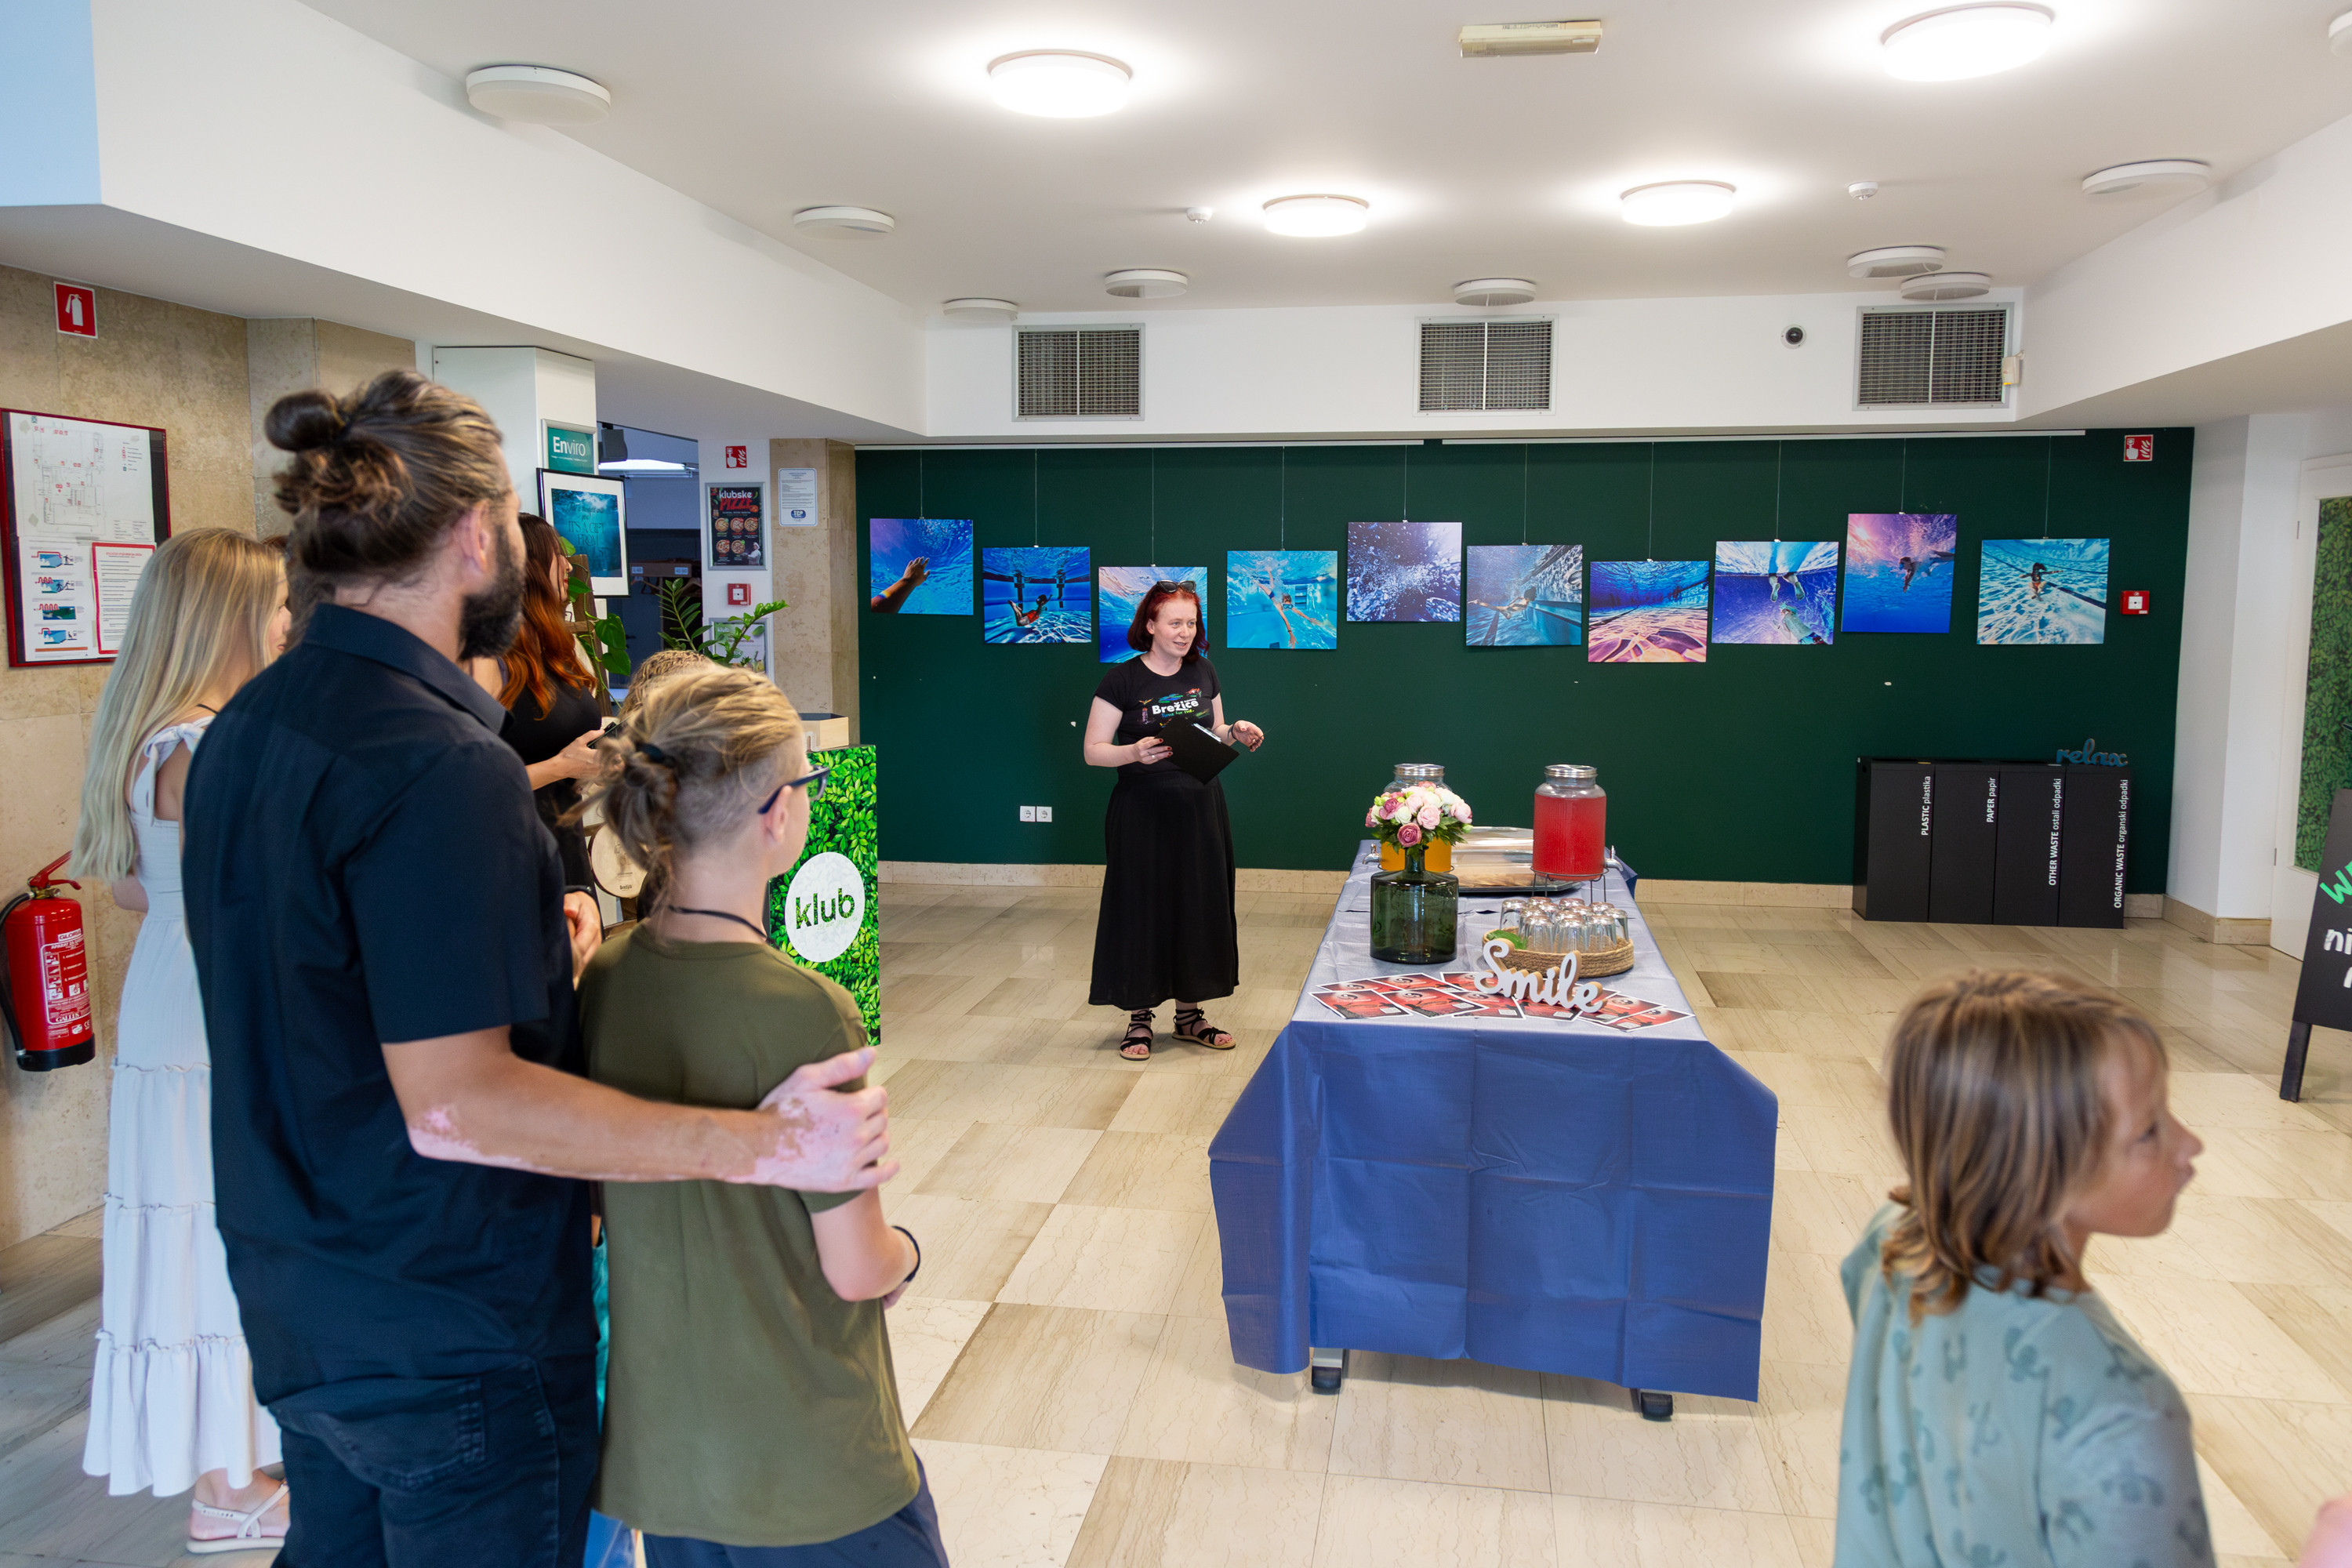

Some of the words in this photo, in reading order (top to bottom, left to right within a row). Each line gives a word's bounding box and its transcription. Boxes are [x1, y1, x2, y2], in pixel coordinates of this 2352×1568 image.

[553, 436, 586, 456] Enviro
[719, 490, 753, 499] klubske
[720, 498, 753, 511] PIZZE
[577, 534, 598, 546] FROM
[590, 522, 604, 534] GIFT
[1152, 699, 1199, 715] Brežice
[2056, 739, 2129, 768] relax
[1922, 776, 1932, 804] plastika
[1988, 777, 1998, 797] papir
[2053, 779, 2063, 809] odpadki
[2118, 779, 2129, 810] odpadki
[1921, 805, 1930, 836] PLASTIC
[1986, 798, 1995, 823] PAPER
[2051, 810, 2060, 830] ostali
[2118, 811, 2128, 843] organski
[2049, 831, 2059, 858] WASTE
[2115, 844, 2125, 871] WASTE
[2048, 859, 2058, 886] OTHER
[2319, 860, 2352, 905] W
[2114, 872, 2124, 909] ORGANIC
[795, 887, 855, 930] klub
[1474, 938, 1605, 1014] Smile
